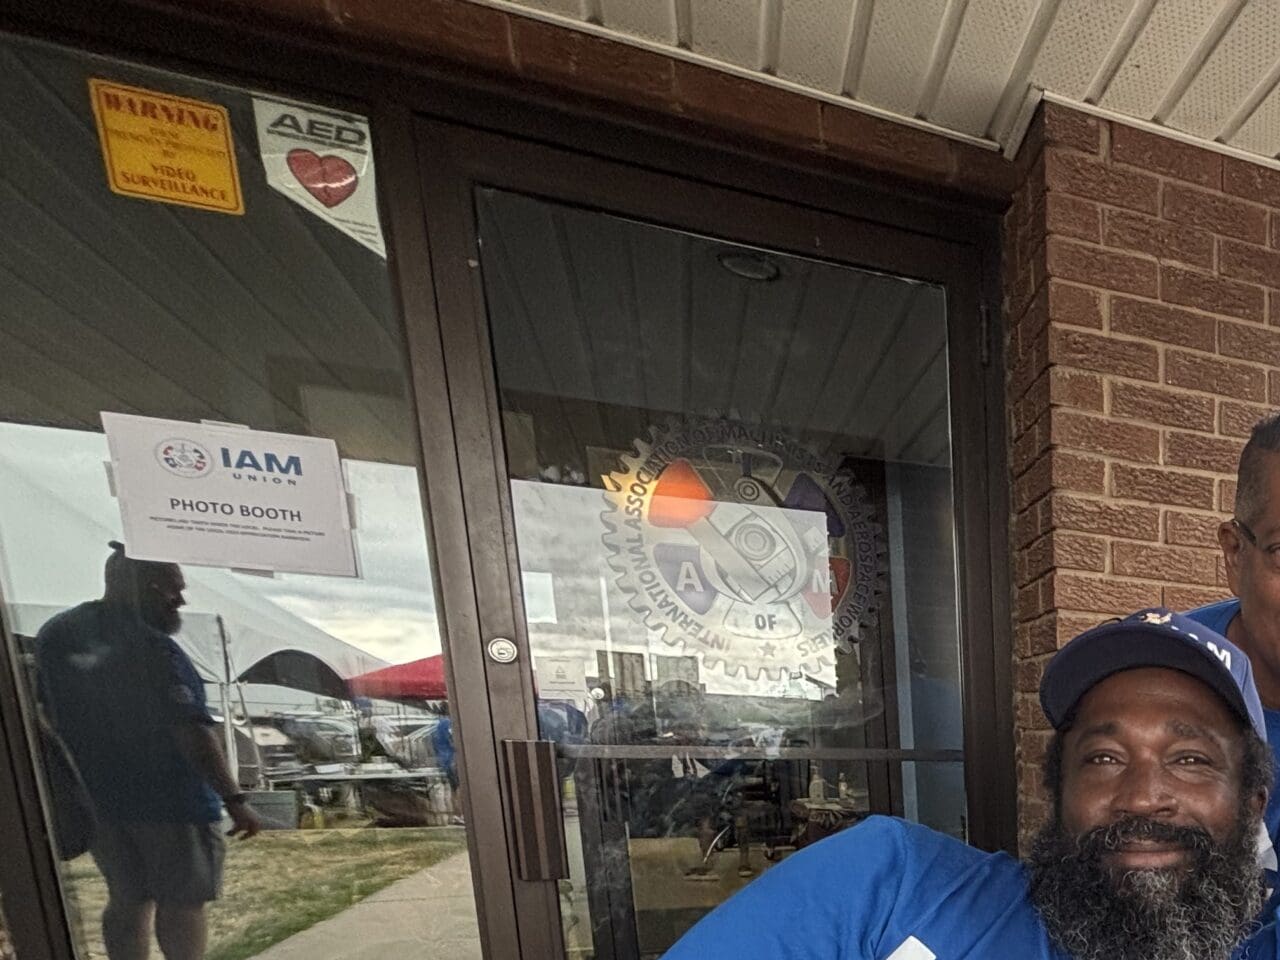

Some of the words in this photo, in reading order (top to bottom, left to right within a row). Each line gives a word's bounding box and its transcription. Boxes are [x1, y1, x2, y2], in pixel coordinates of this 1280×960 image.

[102, 91, 219, 133] WARNING
[268, 113, 367, 145] AED
[119, 170, 227, 200] SURVEILLANCE
[150, 162, 196, 183] VIDEO
[219, 447, 303, 476] IAM
[232, 473, 298, 486] UNION
[170, 498, 234, 517] PHOTO
[240, 504, 303, 523] BOOTH
[676, 561, 704, 592] A
[624, 535, 732, 653] INTERNATIONAL
[754, 613, 778, 632] OF
